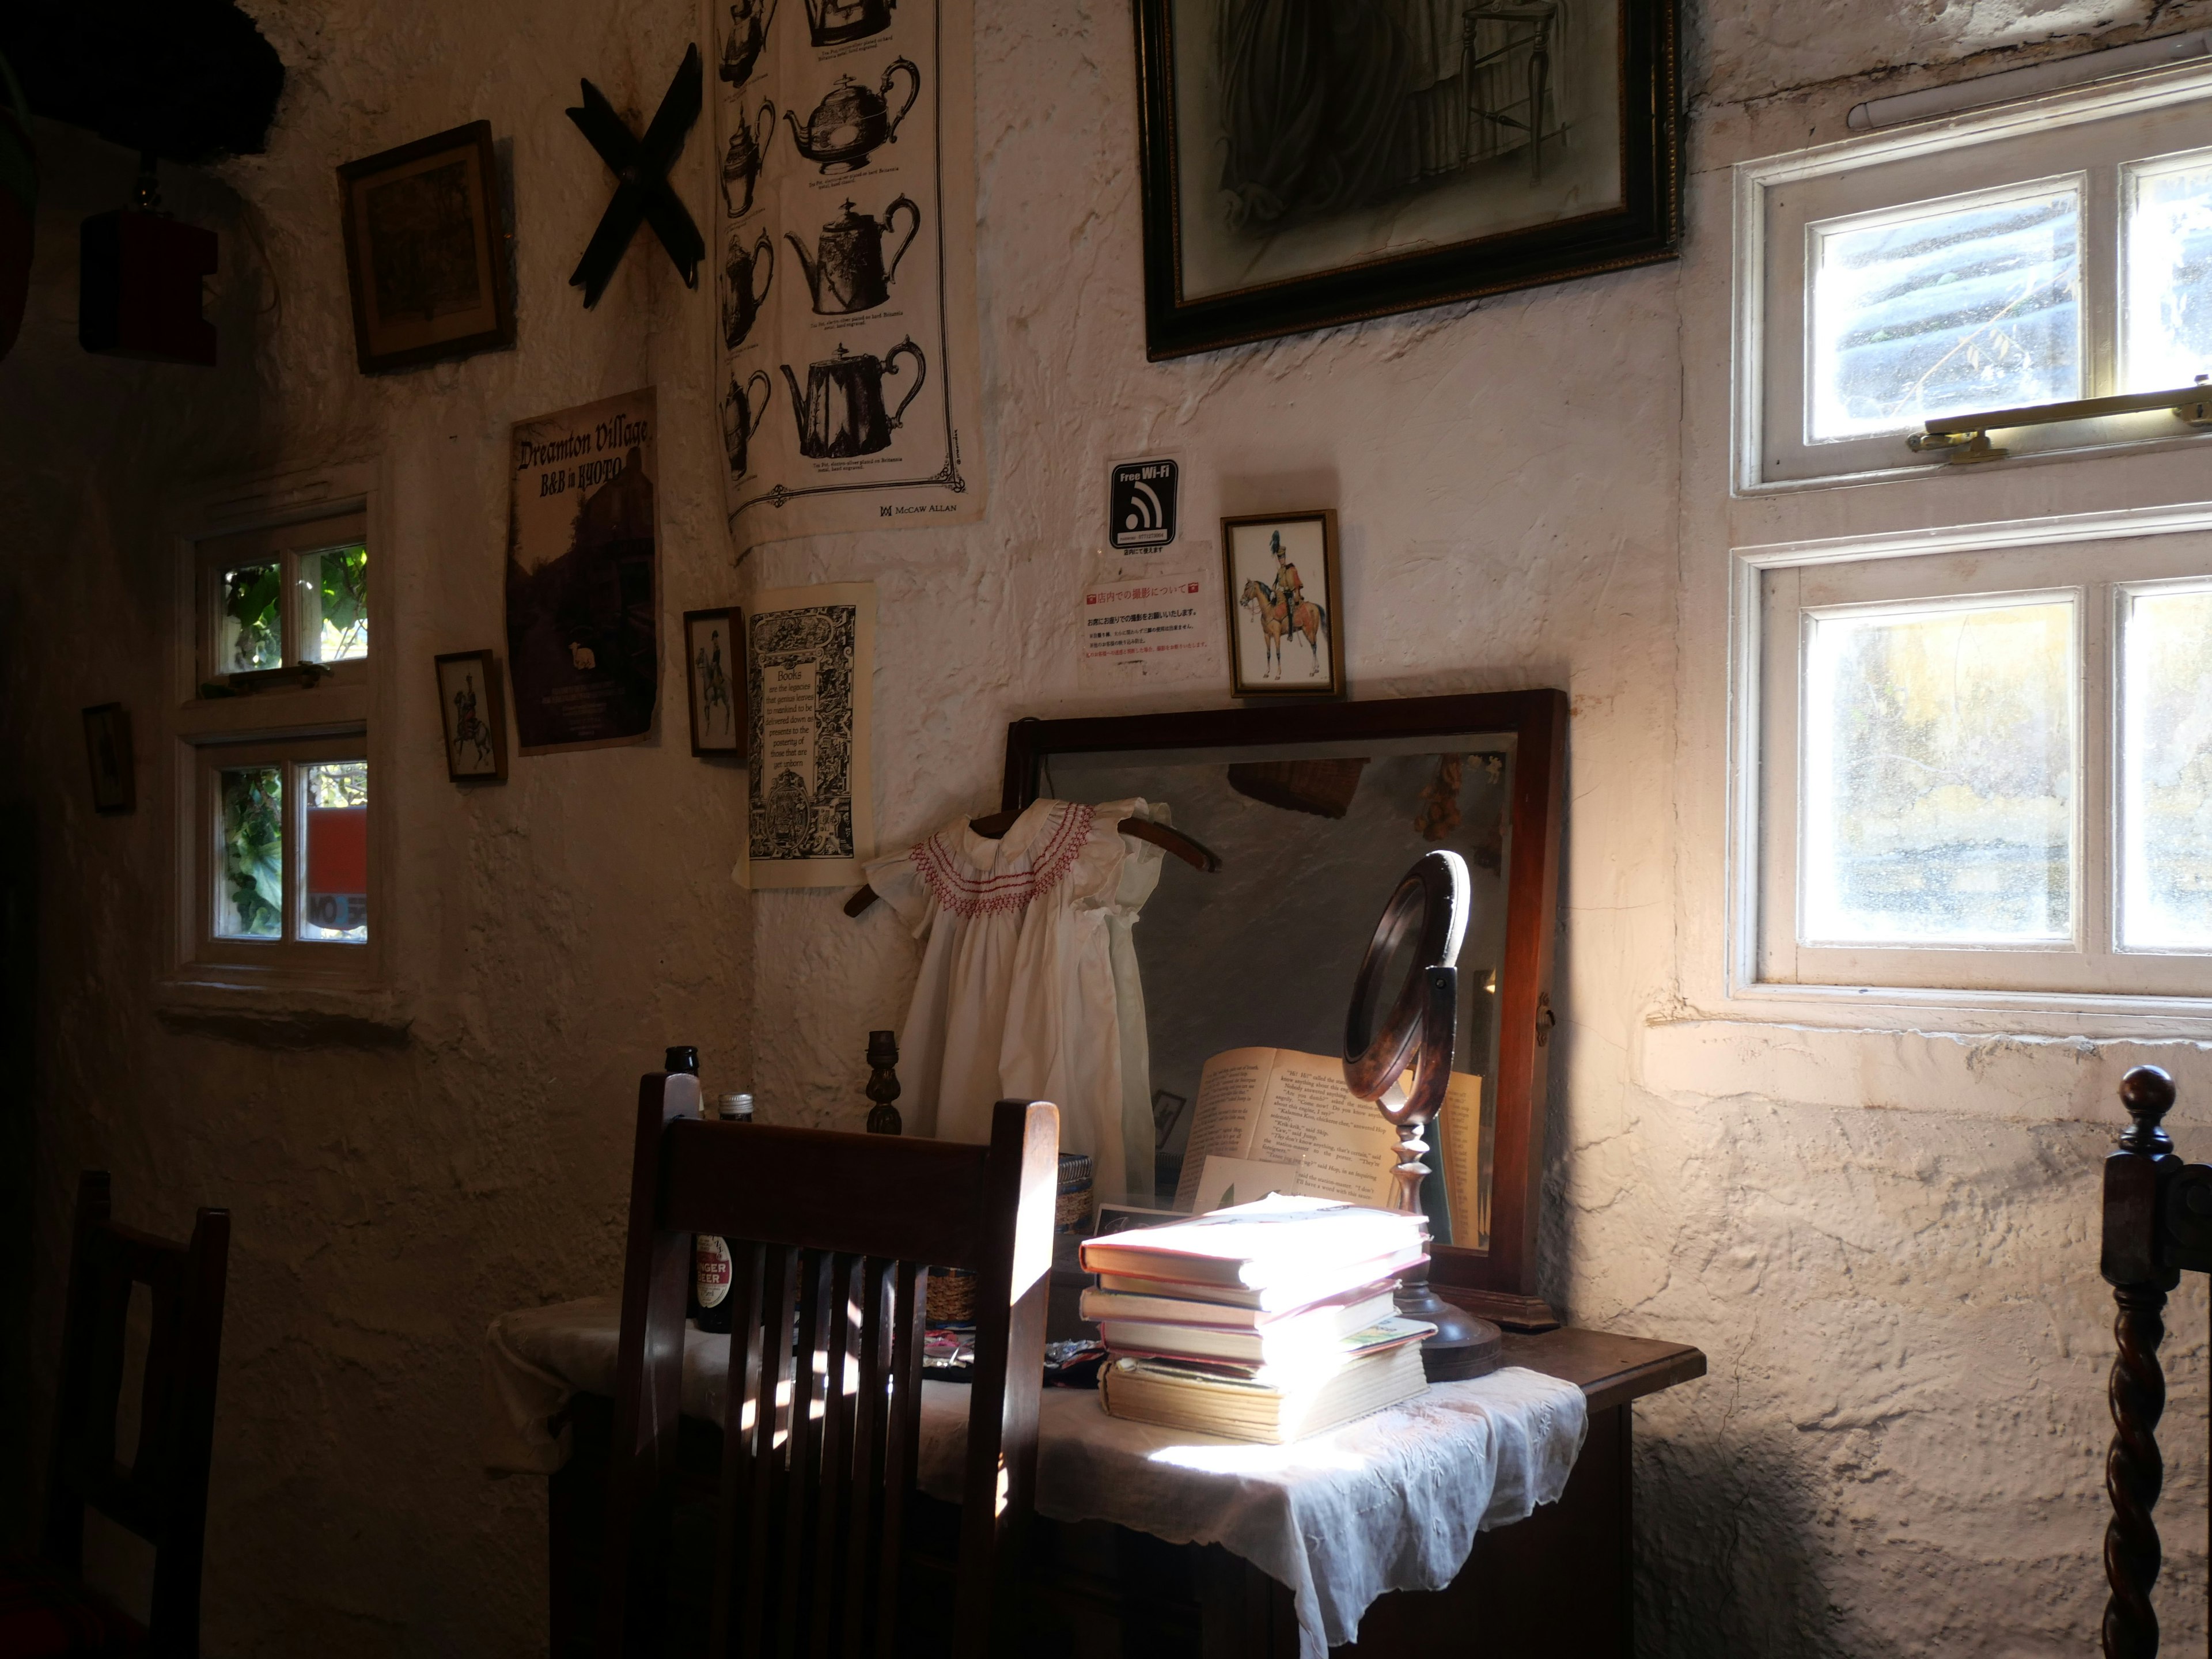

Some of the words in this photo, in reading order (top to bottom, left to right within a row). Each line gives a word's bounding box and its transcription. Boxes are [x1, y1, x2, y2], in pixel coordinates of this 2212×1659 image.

[517, 429, 591, 471] Dreamton
[595, 413, 648, 452] Village
[540, 469, 566, 498] B&B
[568, 467, 575, 488] in
[578, 457, 622, 492] KYOTO
[1120, 472, 1141, 483] Free
[1142, 464, 1170, 480] Wi-Fi
[929, 504, 957, 513] ALLAN
[1124, 546, 1164, 556] 店内にて使えます
[1097, 584, 1187, 604] 店内での撮影について
[1087, 608, 1198, 627] お席にお座りでの撮影をお願いいたします。
[778, 669, 802, 681] Books
[779, 684, 787, 692] the
[789, 683, 811, 692] legacies
[766, 696, 777, 704] that
[778, 696, 795, 704] genius
[796, 694, 814, 702] leaves
[774, 704, 797, 714] mankind
[805, 703, 813, 712] be
[765, 716, 789, 726] delivered
[790, 715, 806, 724] down
[769, 728, 791, 738] presents
[800, 725, 809, 734] the
[773, 738, 797, 748] posterity
[798, 736, 805, 745] of
[786, 748, 797, 756] that
[774, 760, 782, 770] yet
[783, 759, 803, 767] unborn
[1295, 1080, 1314, 1088] anything
[1285, 1083, 1303, 1092] Nobody
[1327, 1092, 1347, 1100] anything.
[1299, 1106, 1316, 1114] engine,
[1271, 1113, 1293, 1123] solemnly.
[1317, 1129, 1329, 1137] Skip.
[1376, 1126, 1387, 1135] Hop
[1302, 1132, 1317, 1141] Jump.
[1277, 1141, 1309, 1152] station-master
[1313, 1142, 1335, 1152] anything,
[1336, 1146, 1350, 1154] that's
[1328, 1165, 1341, 1173] Hop,
[1318, 1178, 1352, 1189] station-master.
[1361, 1186, 1374, 1194] don't
[698, 1271, 720, 1283] BEER
